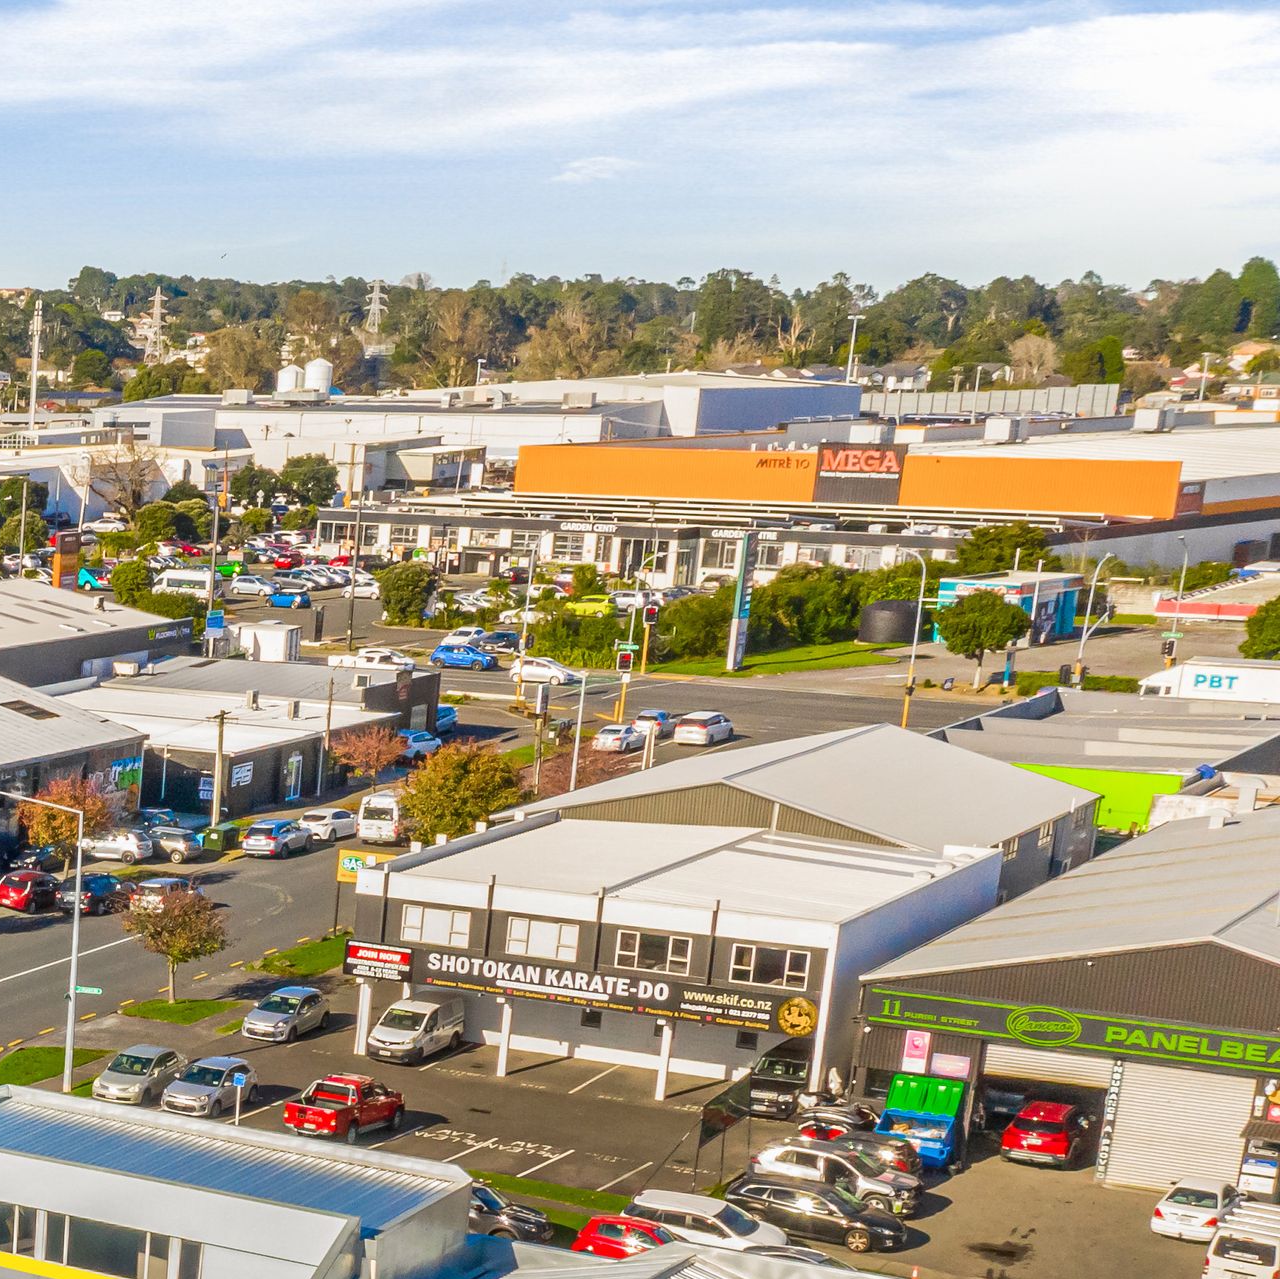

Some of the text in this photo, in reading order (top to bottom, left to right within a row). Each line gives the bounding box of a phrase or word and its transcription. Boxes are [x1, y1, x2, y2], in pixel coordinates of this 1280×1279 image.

[755, 457, 811, 470] MITRE 10
[821, 448, 901, 473] MEGA
[560, 522, 592, 532] GARDEN
[711, 528, 744, 539] GARDEN
[1193, 673, 1239, 690] PBT
[342, 858, 362, 870] SAS
[357, 949, 402, 963] JOIN NOW
[427, 952, 539, 984] SHOTOKAN
[544, 968, 669, 1001] KARATE-DO
[683, 990, 773, 1011] www.skif.co.nz
[881, 999, 980, 1027] 11 PURIRI STREET
[1013, 1014, 1075, 1033] Cameron
